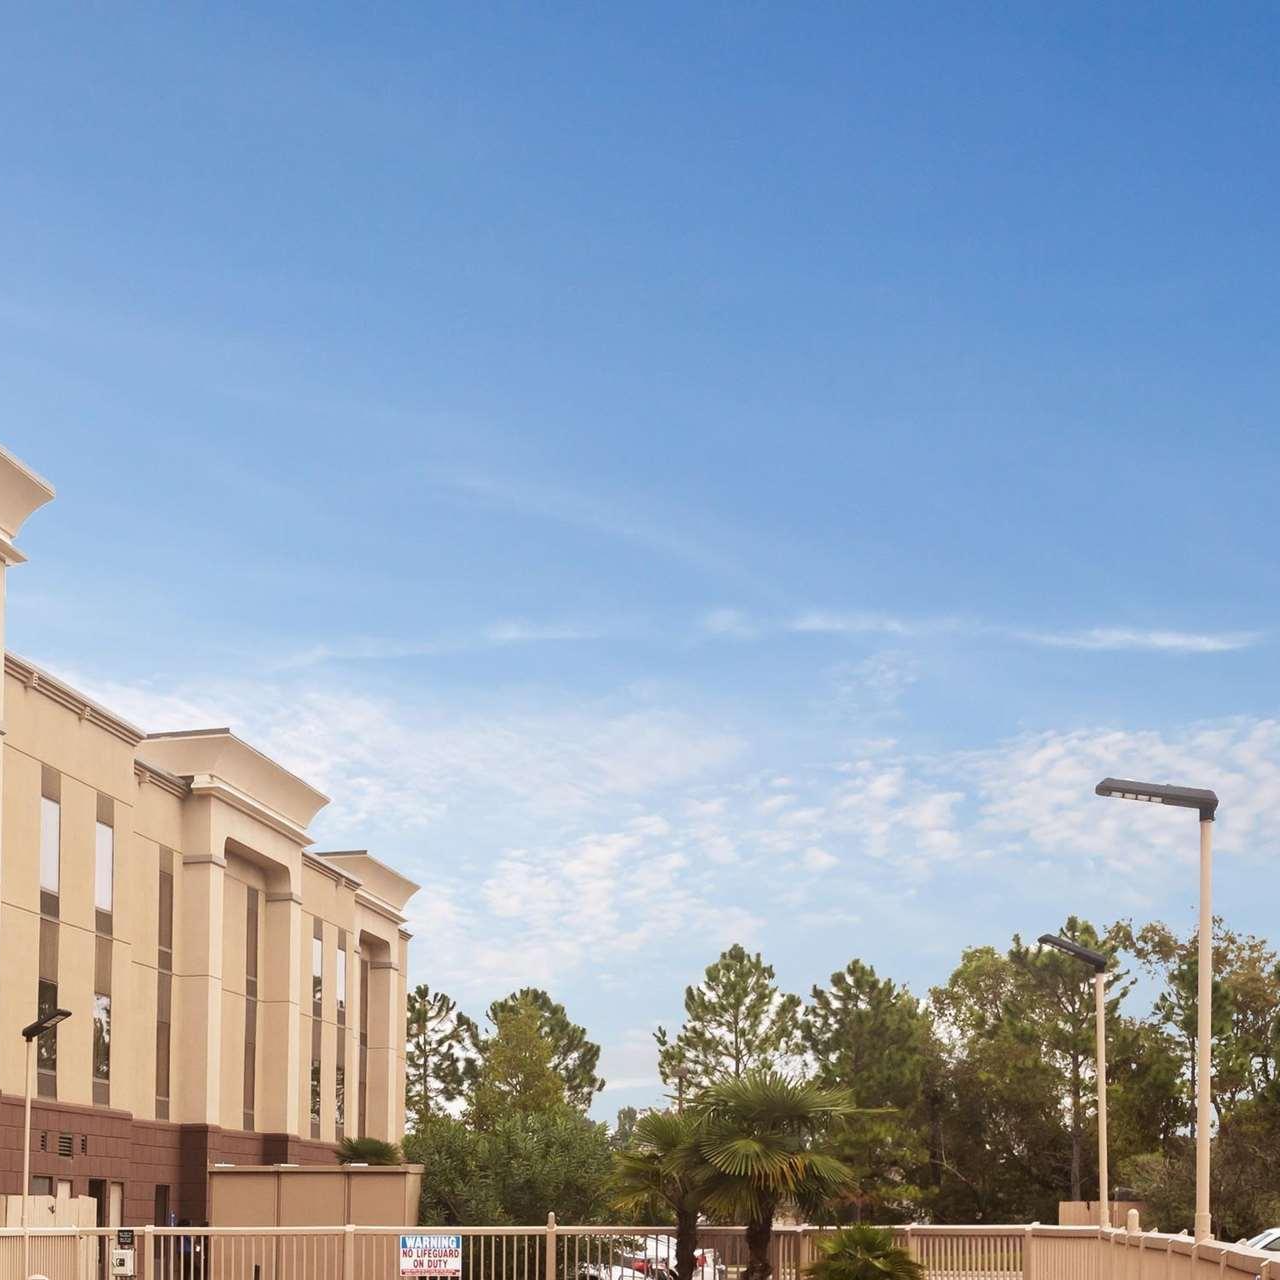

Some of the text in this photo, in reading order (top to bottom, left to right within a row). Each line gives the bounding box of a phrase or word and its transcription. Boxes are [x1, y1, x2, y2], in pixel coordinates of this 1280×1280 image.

[405, 1236, 457, 1249] WARNING
[402, 1249, 460, 1258] NO LIFEGUARD
[413, 1259, 448, 1269] ON DUTY
